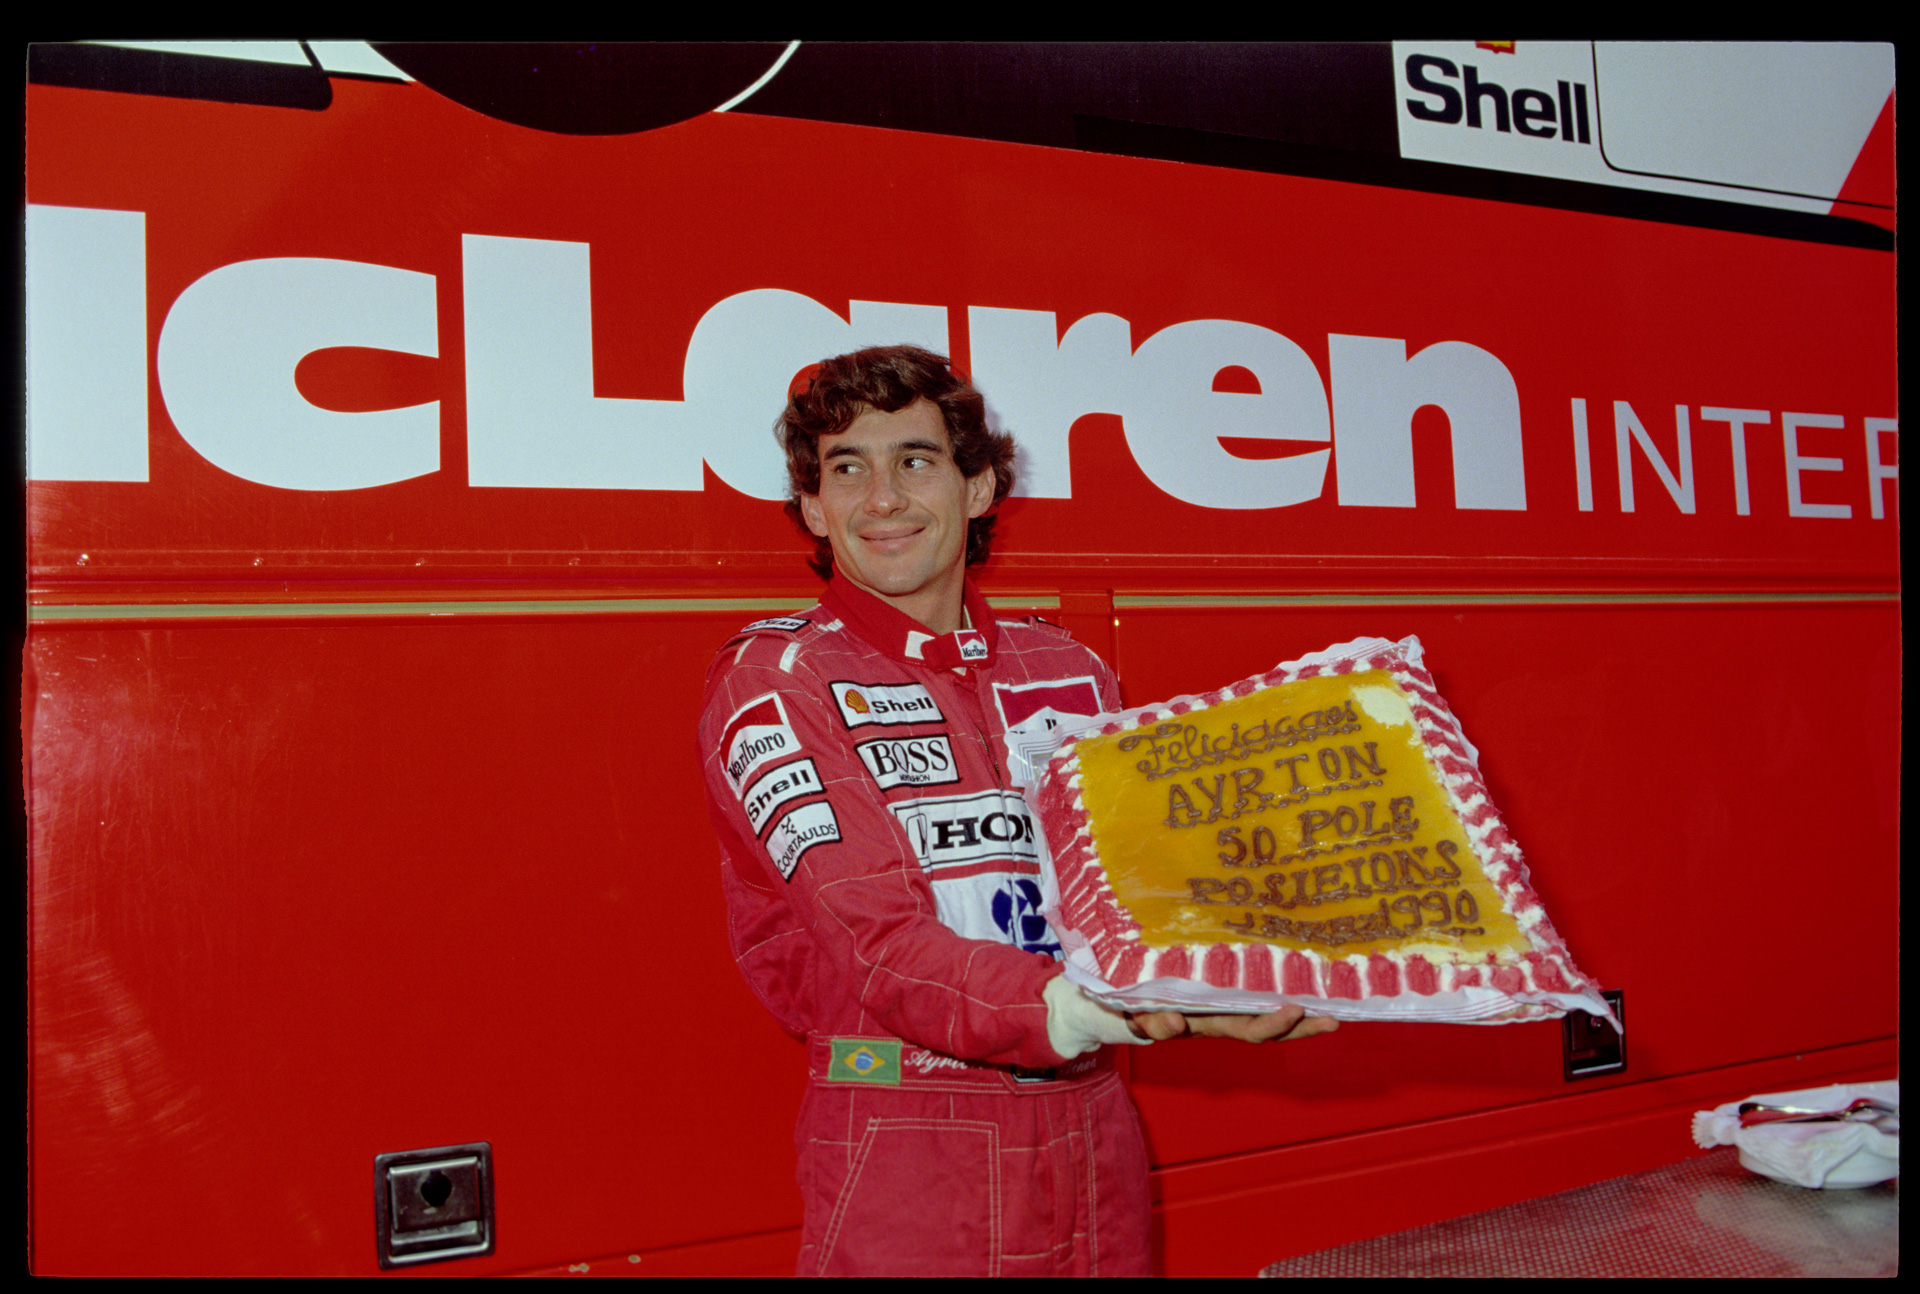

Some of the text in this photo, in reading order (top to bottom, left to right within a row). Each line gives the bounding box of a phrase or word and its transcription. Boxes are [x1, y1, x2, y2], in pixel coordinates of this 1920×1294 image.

[1405, 53, 1591, 145] Shell
[871, 697, 934, 714] Shell
[728, 732, 786, 786] Marlboro
[866, 740, 949, 777] BOSS
[1164, 741, 1387, 826] AYRTON
[748, 769, 811, 823] Shell
[777, 823, 837, 873] COURTAULDS
[1217, 796, 1420, 866] 50 POLE
[1377, 888, 1480, 935] 1990
